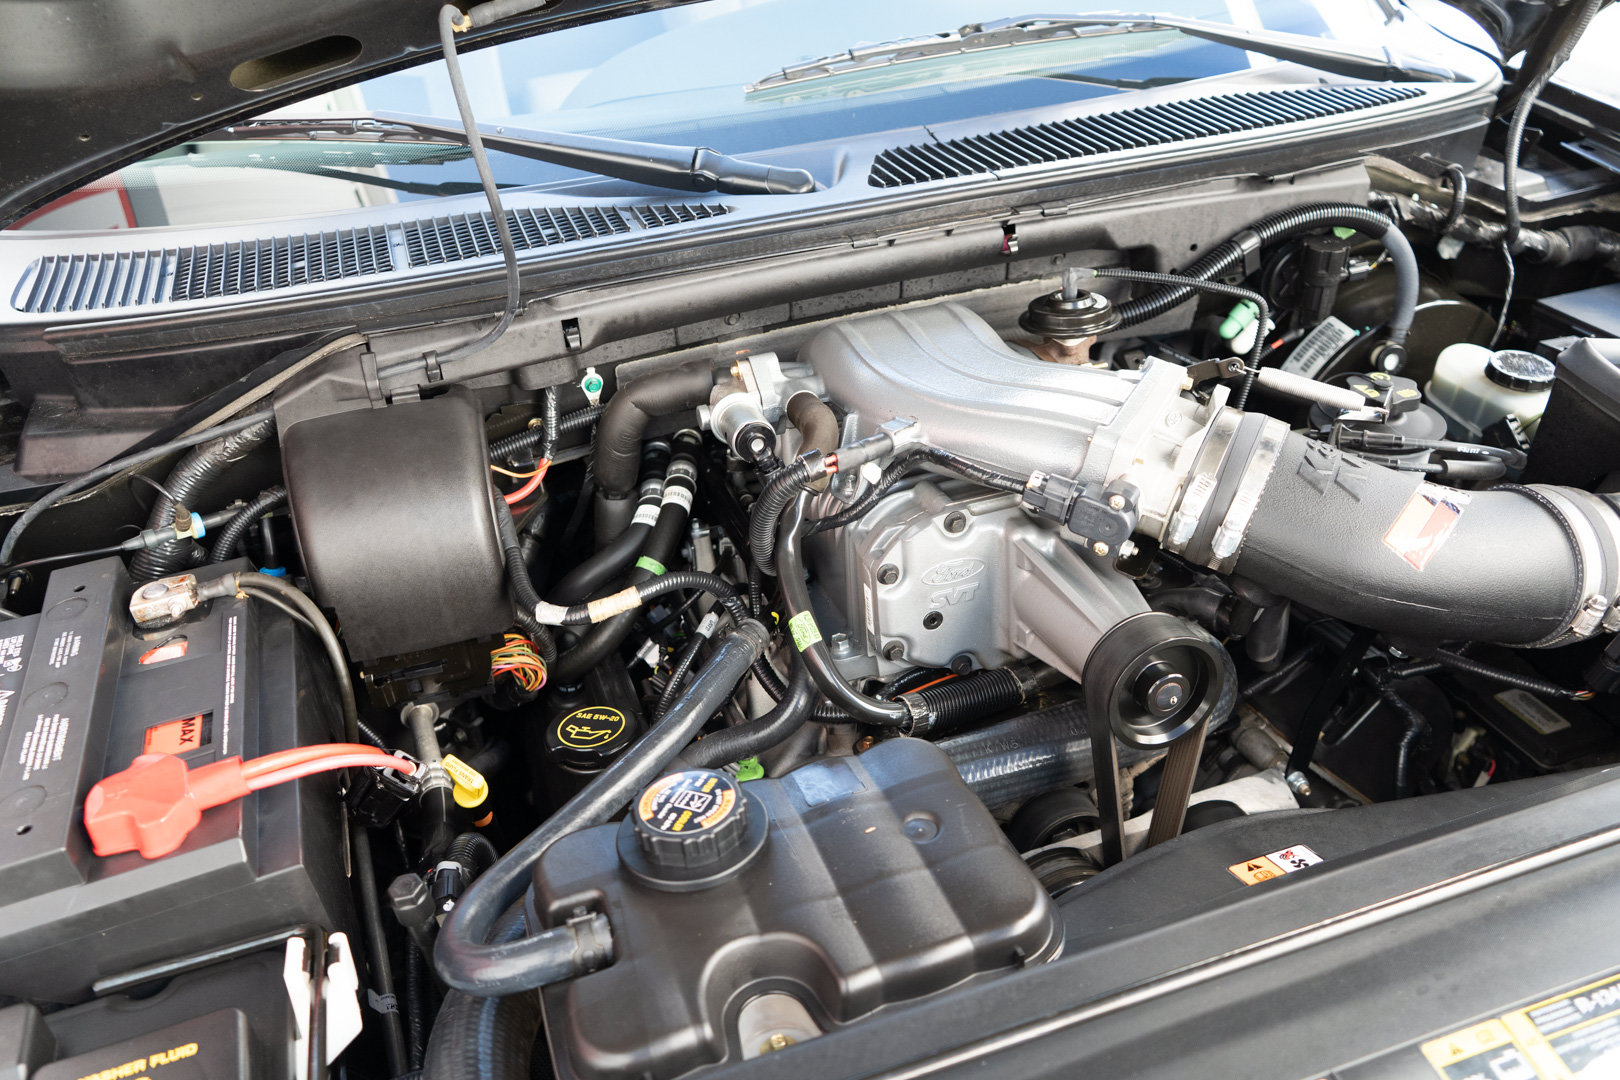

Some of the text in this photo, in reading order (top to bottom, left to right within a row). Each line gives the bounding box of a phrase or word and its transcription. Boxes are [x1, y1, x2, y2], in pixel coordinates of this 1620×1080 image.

[932, 561, 974, 583] Ford
[930, 582, 980, 609] SVT
[593, 713, 620, 722] 5W-20
[179, 716, 196, 746] MAX
[672, 810, 692, 831] COOLER
[149, 1042, 199, 1069] FLUID
